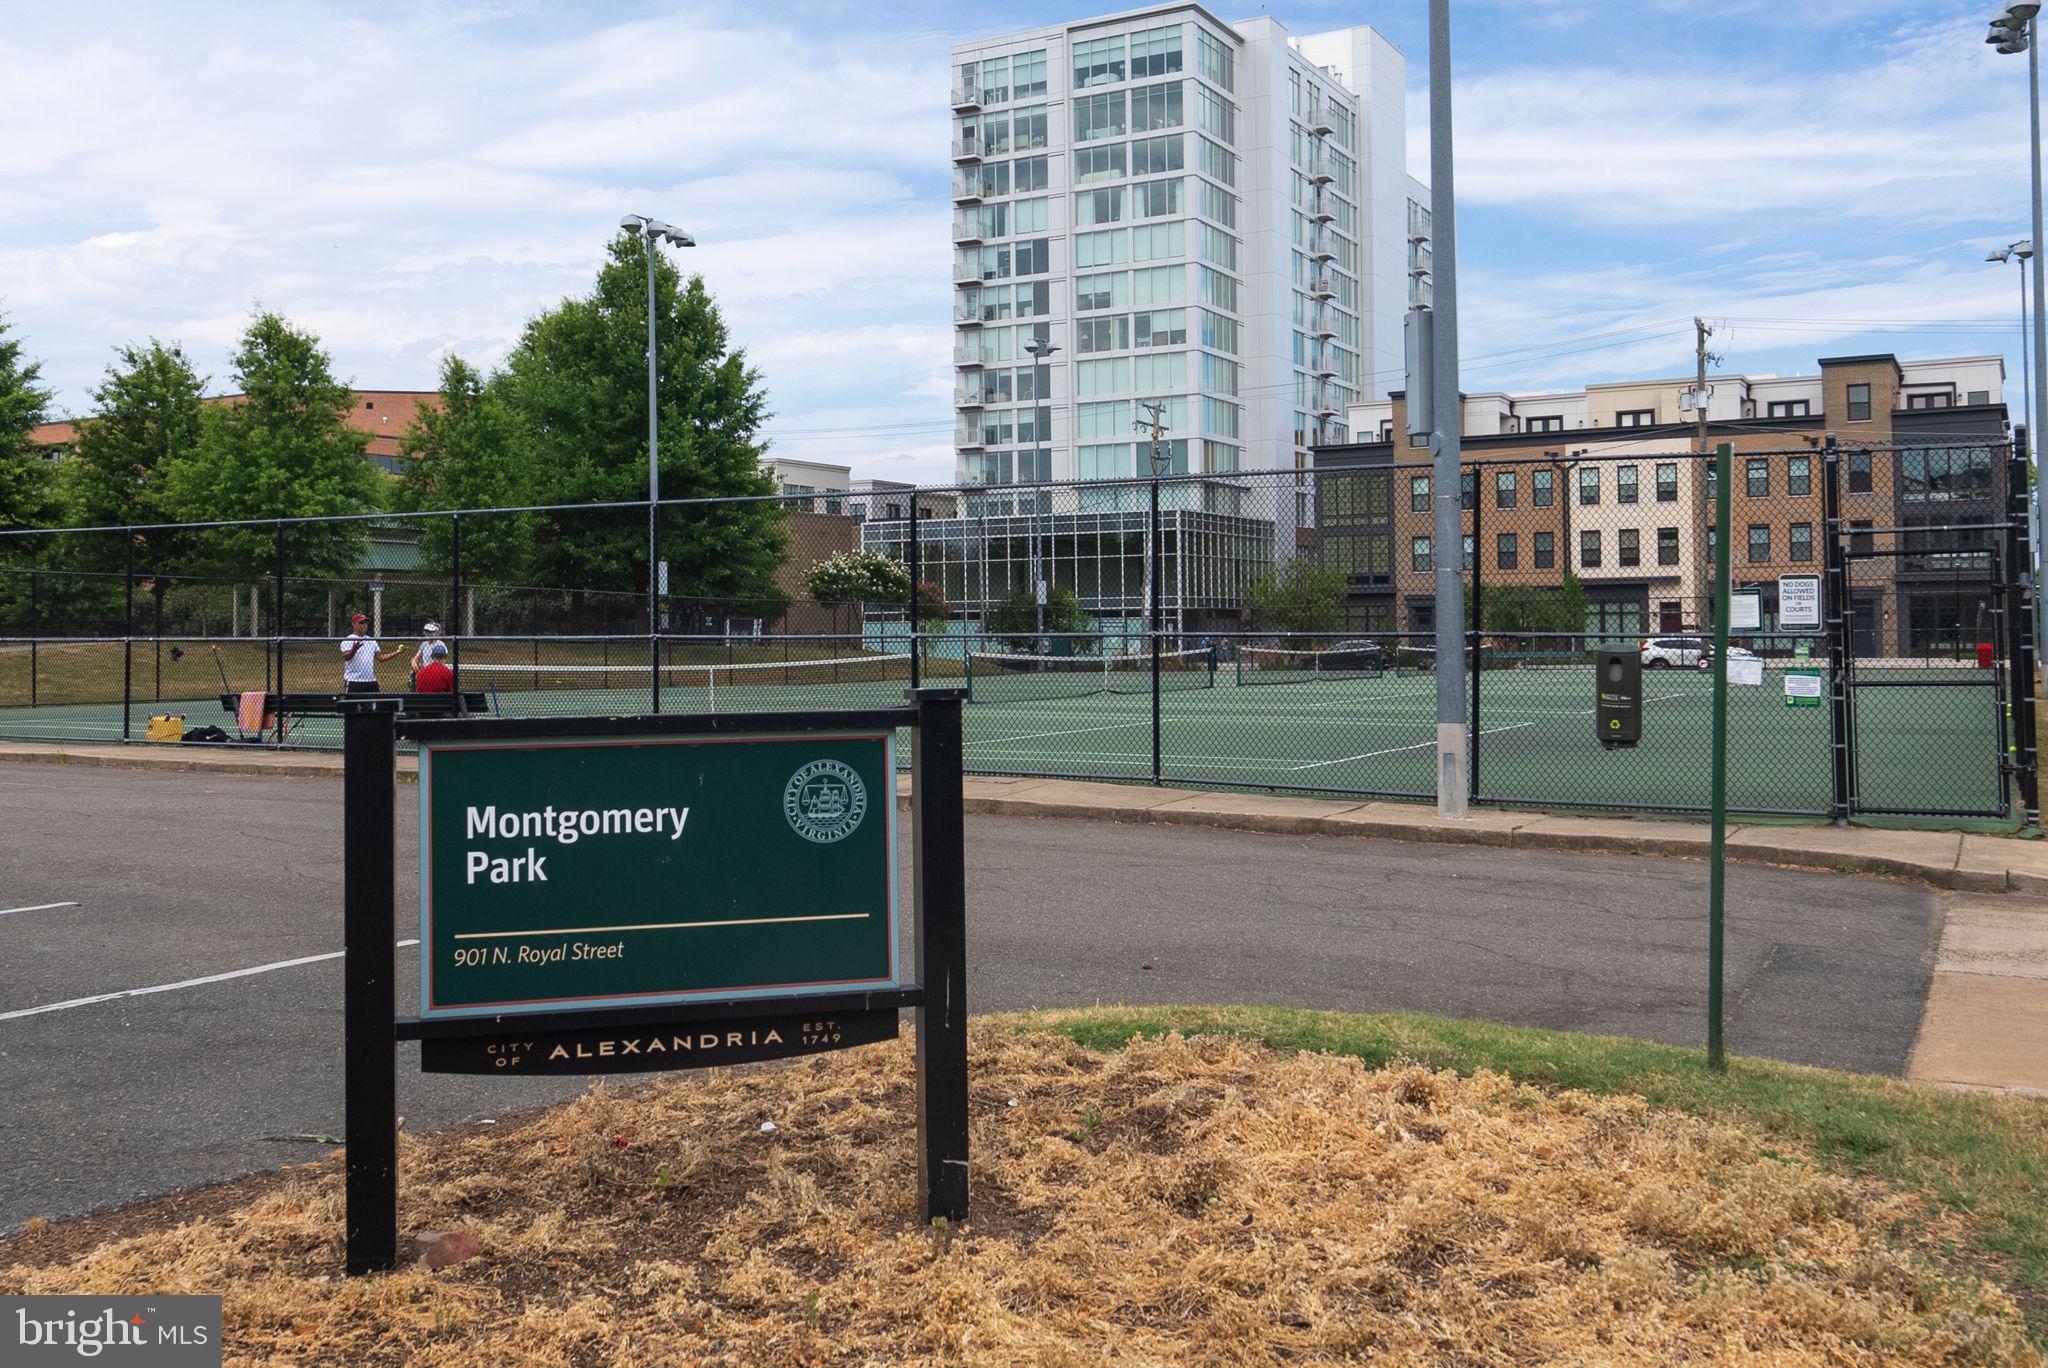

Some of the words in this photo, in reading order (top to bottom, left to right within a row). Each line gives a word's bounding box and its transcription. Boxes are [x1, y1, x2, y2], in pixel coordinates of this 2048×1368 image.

[787, 783, 798, 816] CITY
[794, 769, 808, 786] OF
[810, 762, 864, 814] ALEXANDRIA
[466, 805, 690, 844] Montgomery
[795, 819, 857, 840] VIRGINIA
[466, 847, 548, 885] Park
[454, 947, 488, 967] 901
[492, 946, 512, 965] N.
[517, 942, 567, 966] Royal
[572, 941, 625, 961] Street
[802, 1021, 842, 1032] EST.
[487, 1042, 534, 1054] CITY
[548, 1029, 784, 1060] ALEXANDRIA
[801, 1033, 842, 1045] 1749
[495, 1056, 521, 1068] OF
